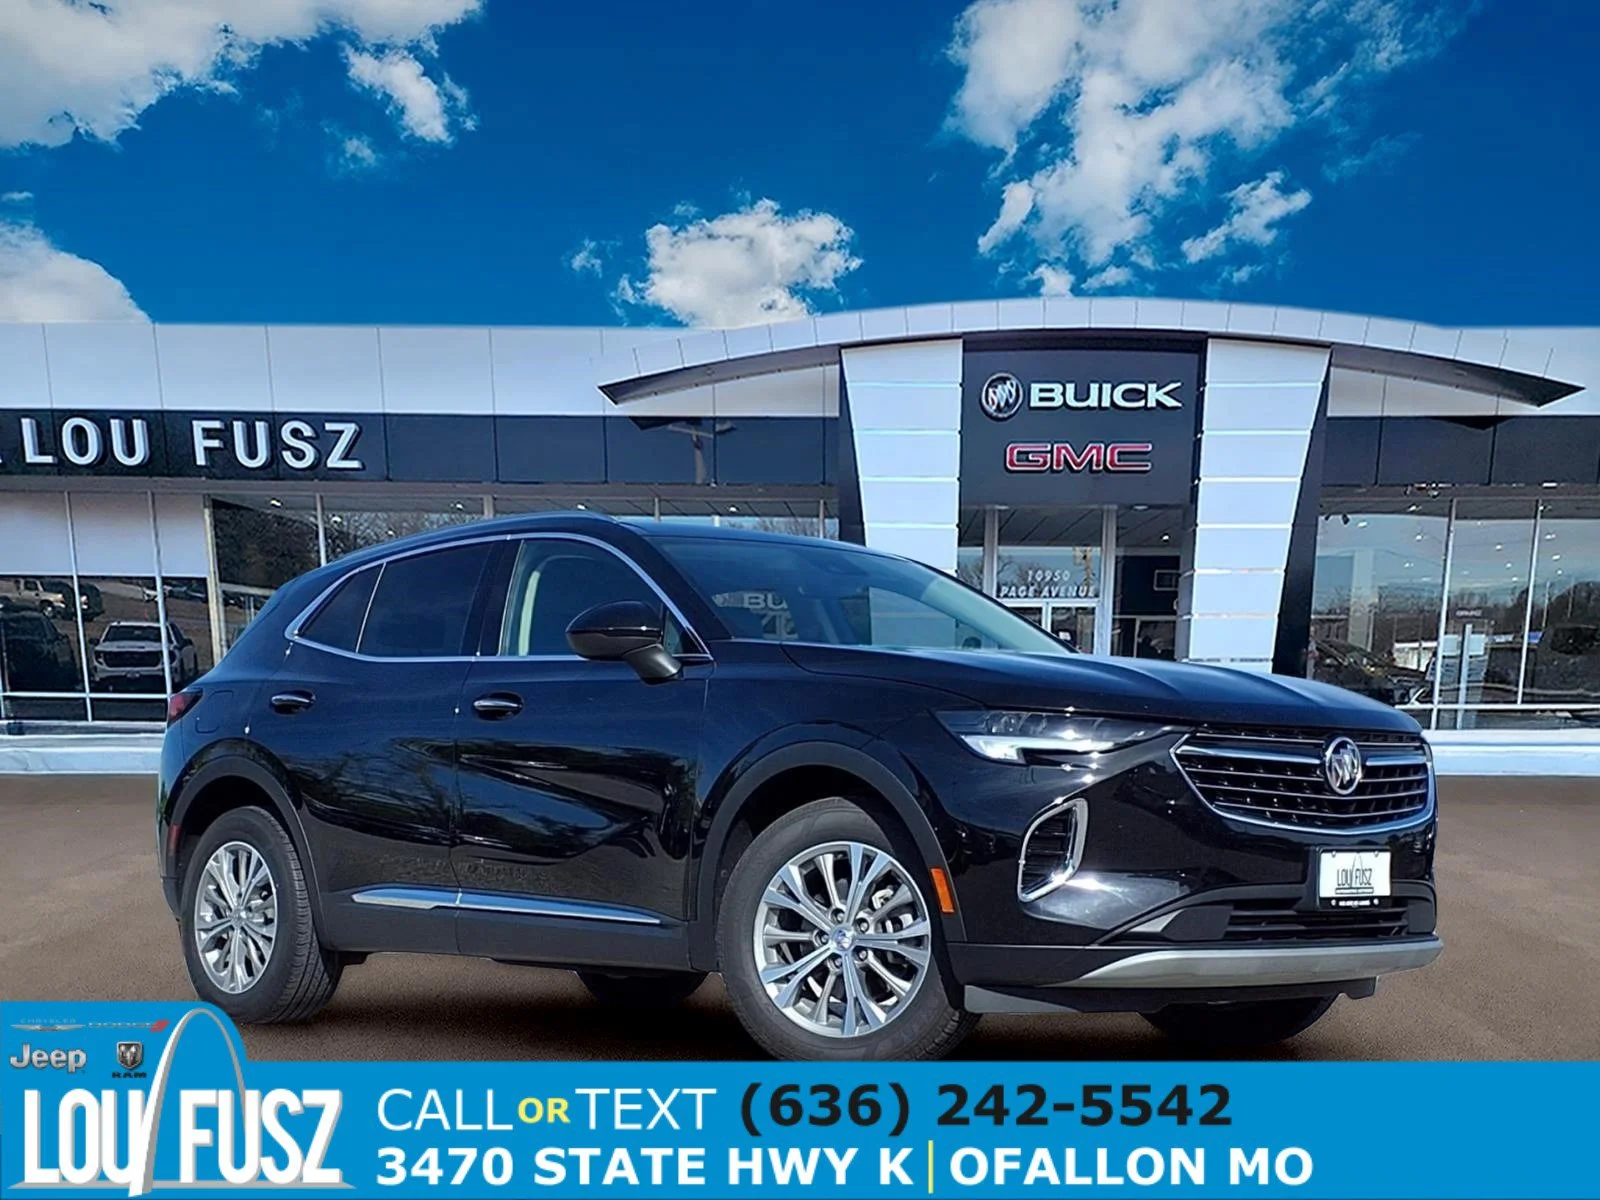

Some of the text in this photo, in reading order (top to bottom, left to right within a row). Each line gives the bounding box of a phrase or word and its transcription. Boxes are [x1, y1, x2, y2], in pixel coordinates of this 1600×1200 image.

[1029, 382, 1183, 409] BUICK
[20, 416, 364, 470] LOU FUSZ
[1005, 442, 1153, 472] GMC
[1000, 585, 1096, 598] PAGE AVENUE
[1336, 868, 1352, 888] LOU
